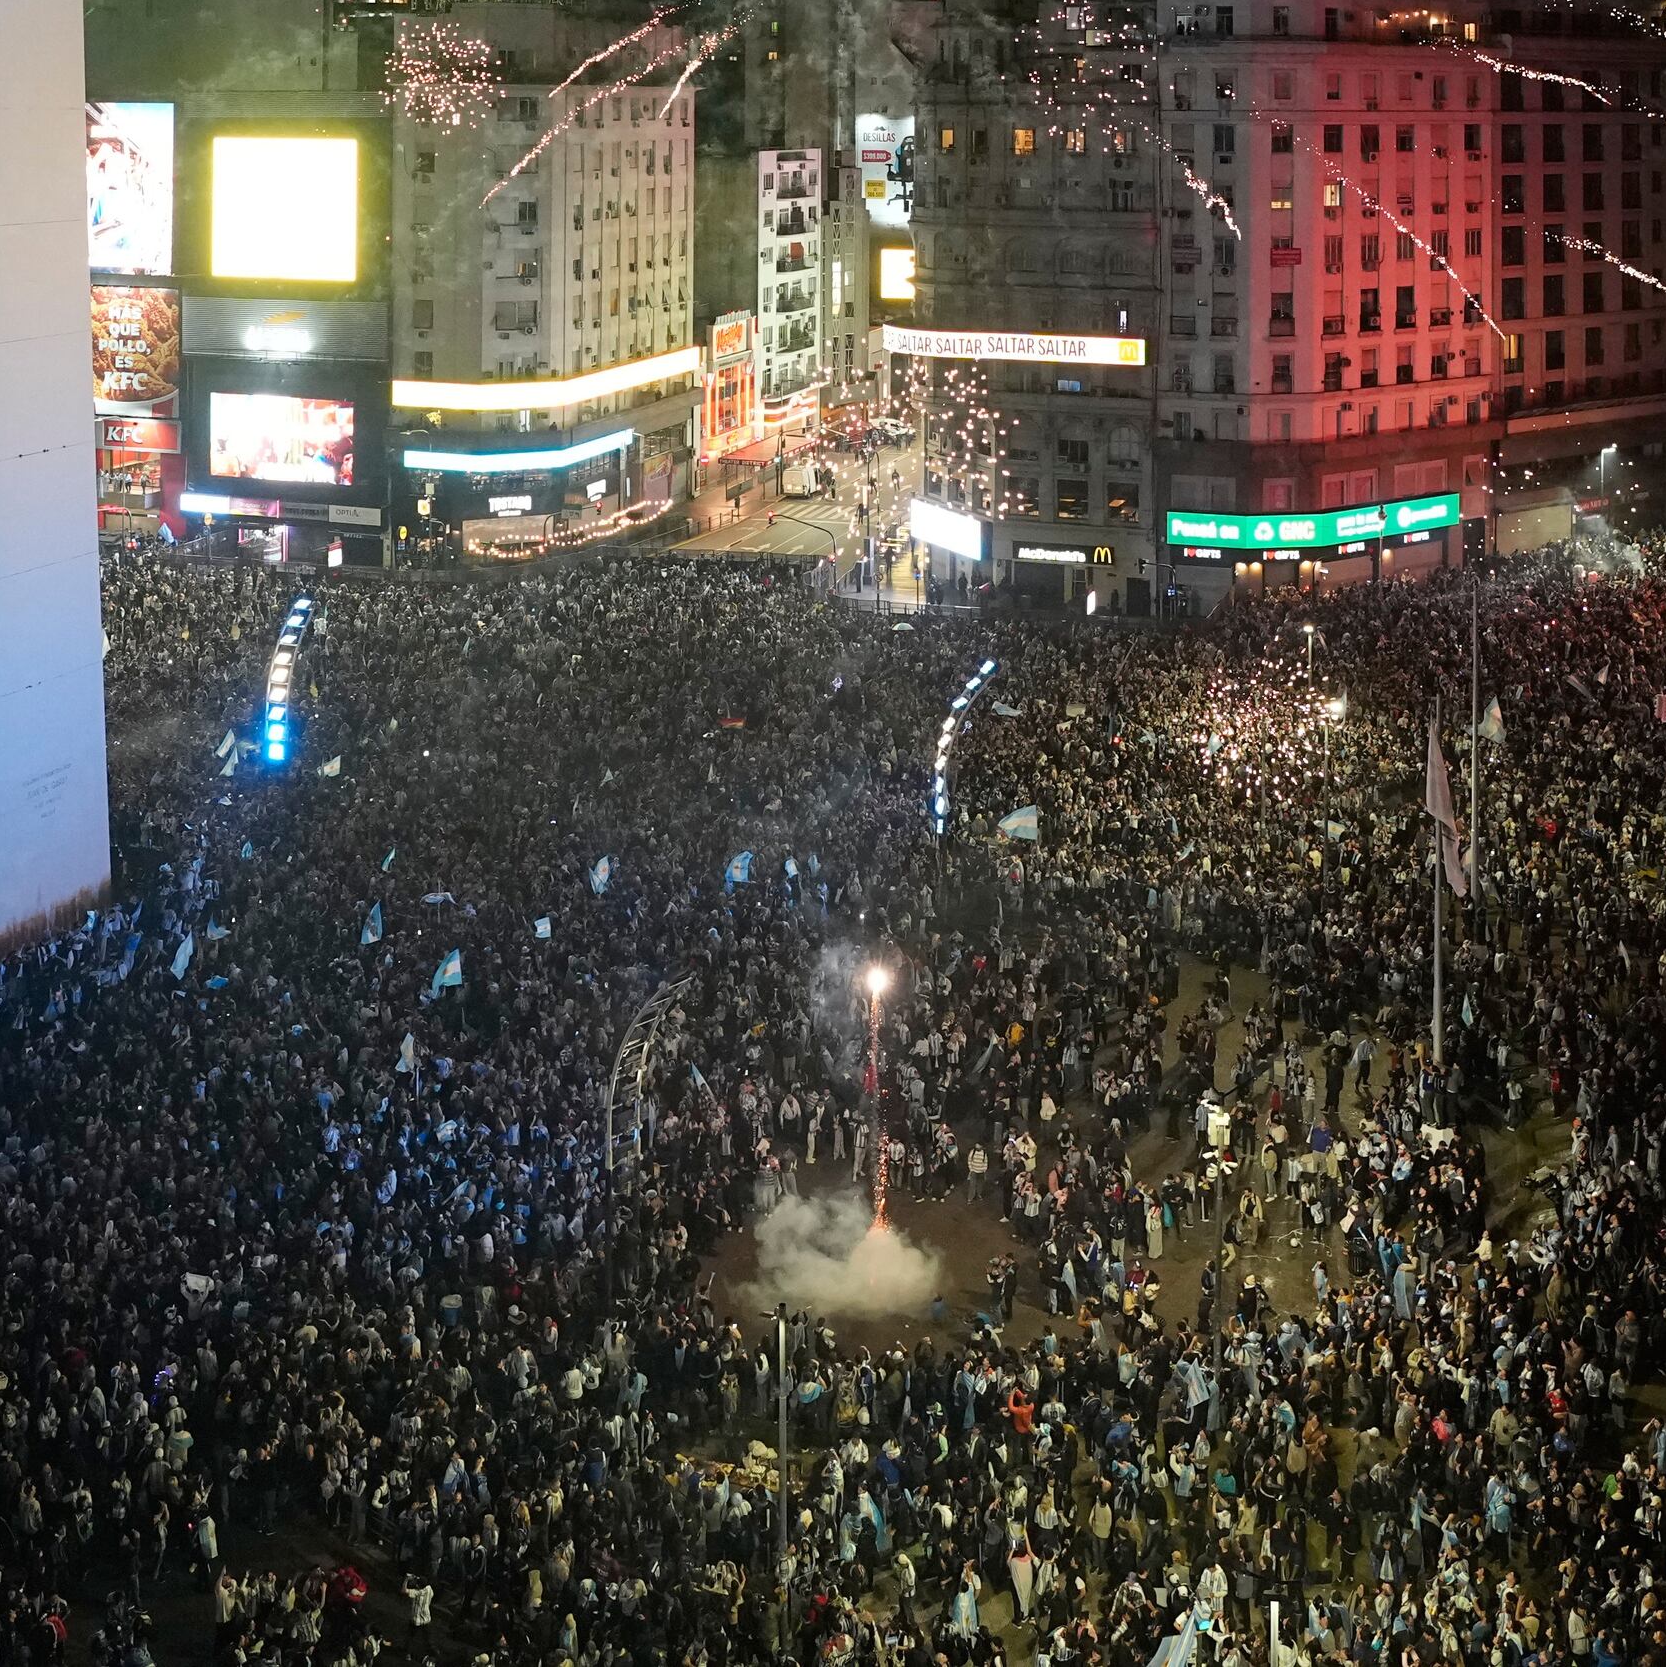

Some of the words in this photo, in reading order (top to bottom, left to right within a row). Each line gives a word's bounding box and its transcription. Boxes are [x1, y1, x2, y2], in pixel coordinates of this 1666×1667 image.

[109, 323, 140, 337] QUE
[98, 339, 151, 354] POLLO,
[897, 333, 932, 353] SALTAR
[935, 337, 983, 355] SALTAR
[987, 336, 1035, 354] SALTAR
[1038, 339, 1087, 357] SALTAR
[115, 356, 133, 368] ES
[103, 372, 148, 391] KFC
[106, 426, 144, 444] KFC
[1018, 547, 1087, 563] McDonald's
